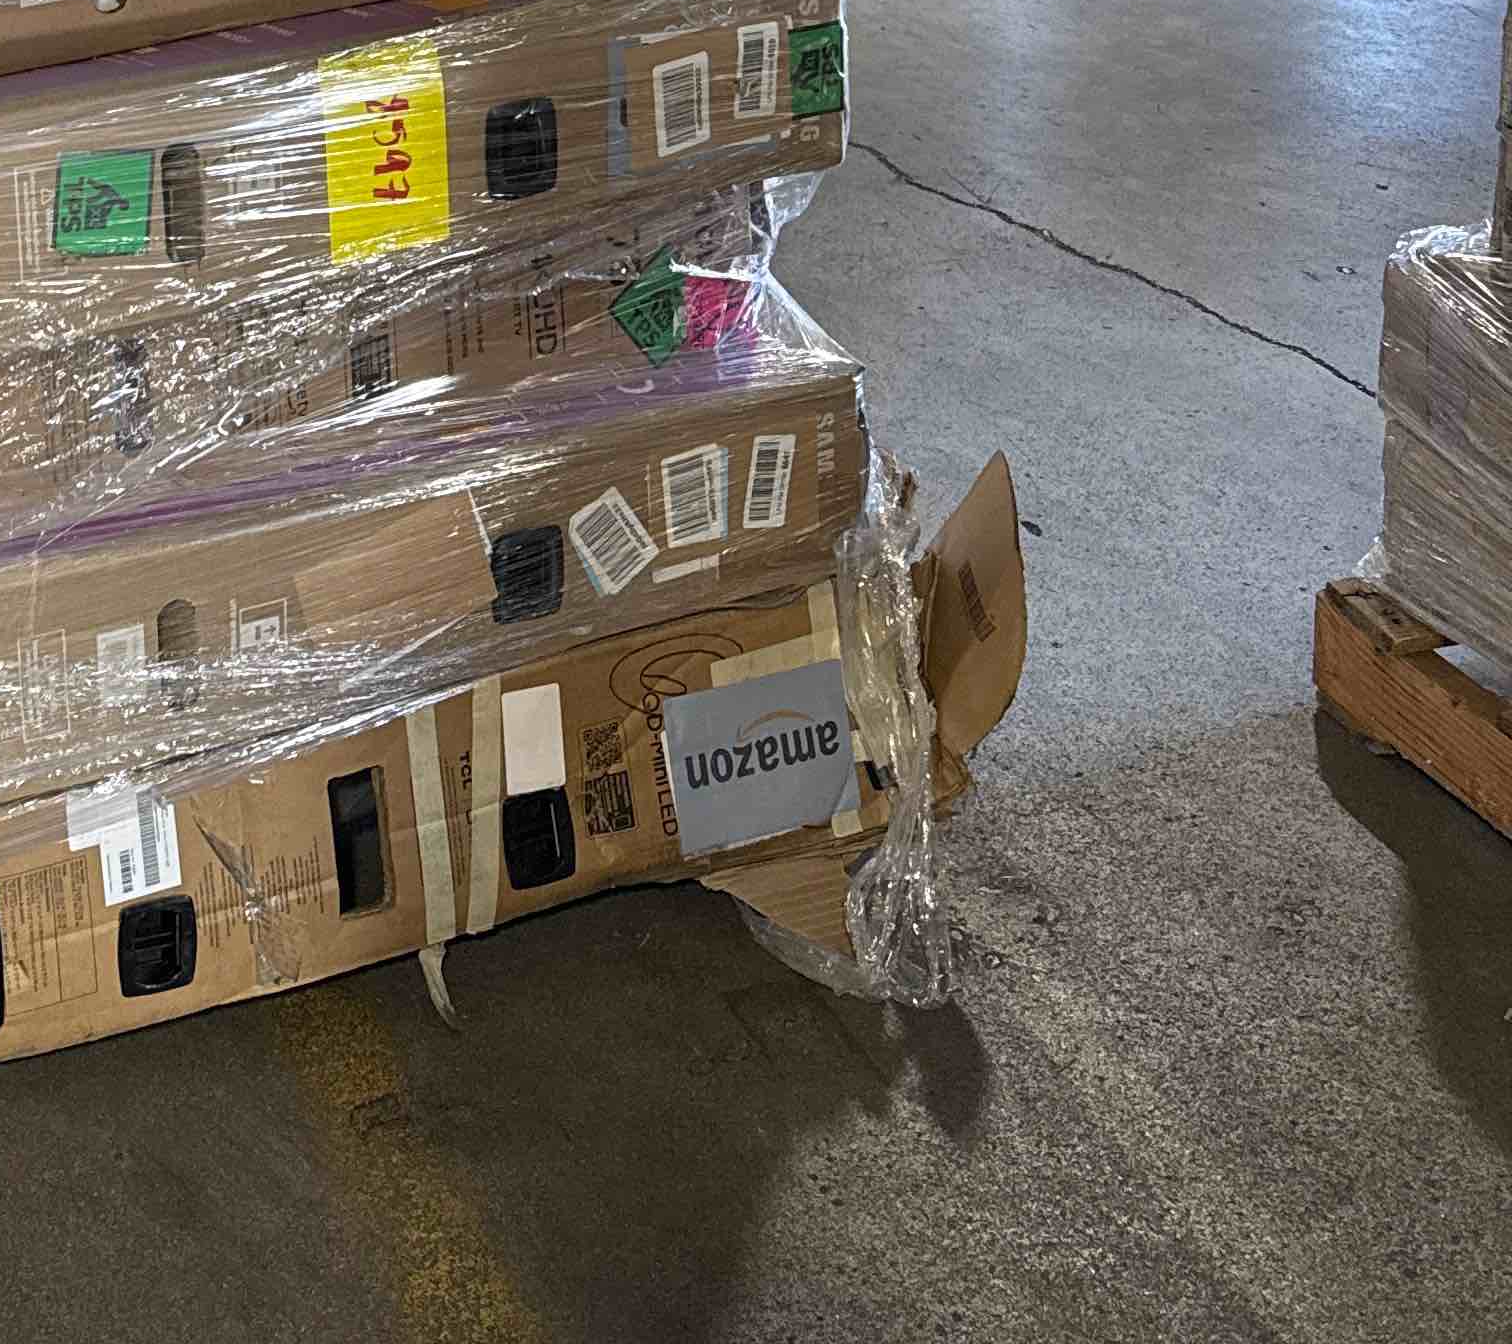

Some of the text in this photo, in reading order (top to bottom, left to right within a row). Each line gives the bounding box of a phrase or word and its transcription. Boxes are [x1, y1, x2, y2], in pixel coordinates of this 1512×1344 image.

[60, 176, 85, 233] TPS
[459, 749, 472, 791] TCL
[642, 691, 680, 837] QD-Mini LED
[684, 720, 840, 791] amazon
